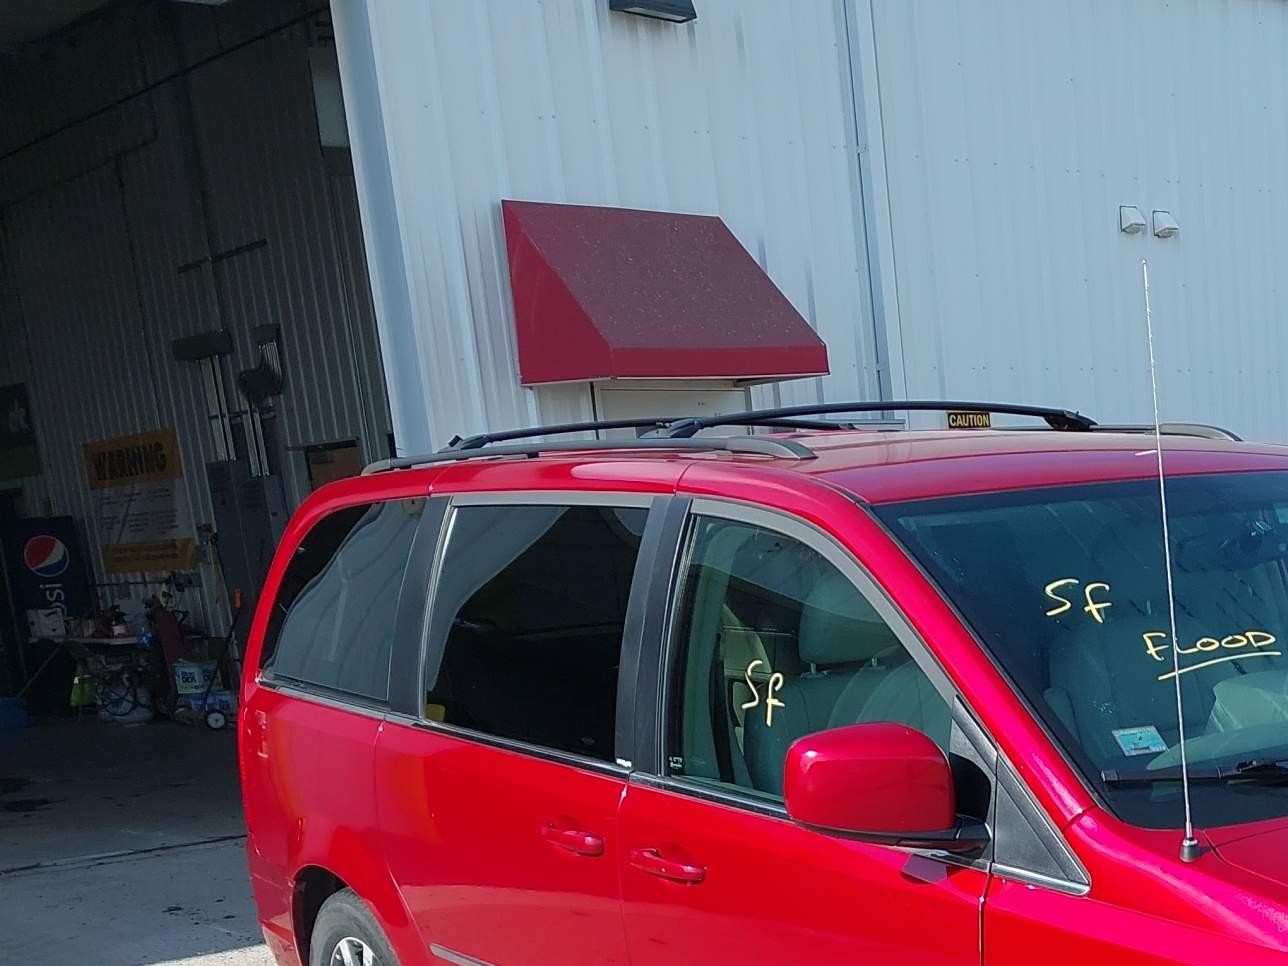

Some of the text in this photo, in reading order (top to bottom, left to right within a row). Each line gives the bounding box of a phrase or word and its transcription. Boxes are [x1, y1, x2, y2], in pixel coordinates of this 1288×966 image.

[948, 413, 991, 428] CAUTION
[94, 441, 167, 481] WARNING
[1142, 631, 1277, 662] FLOOD
